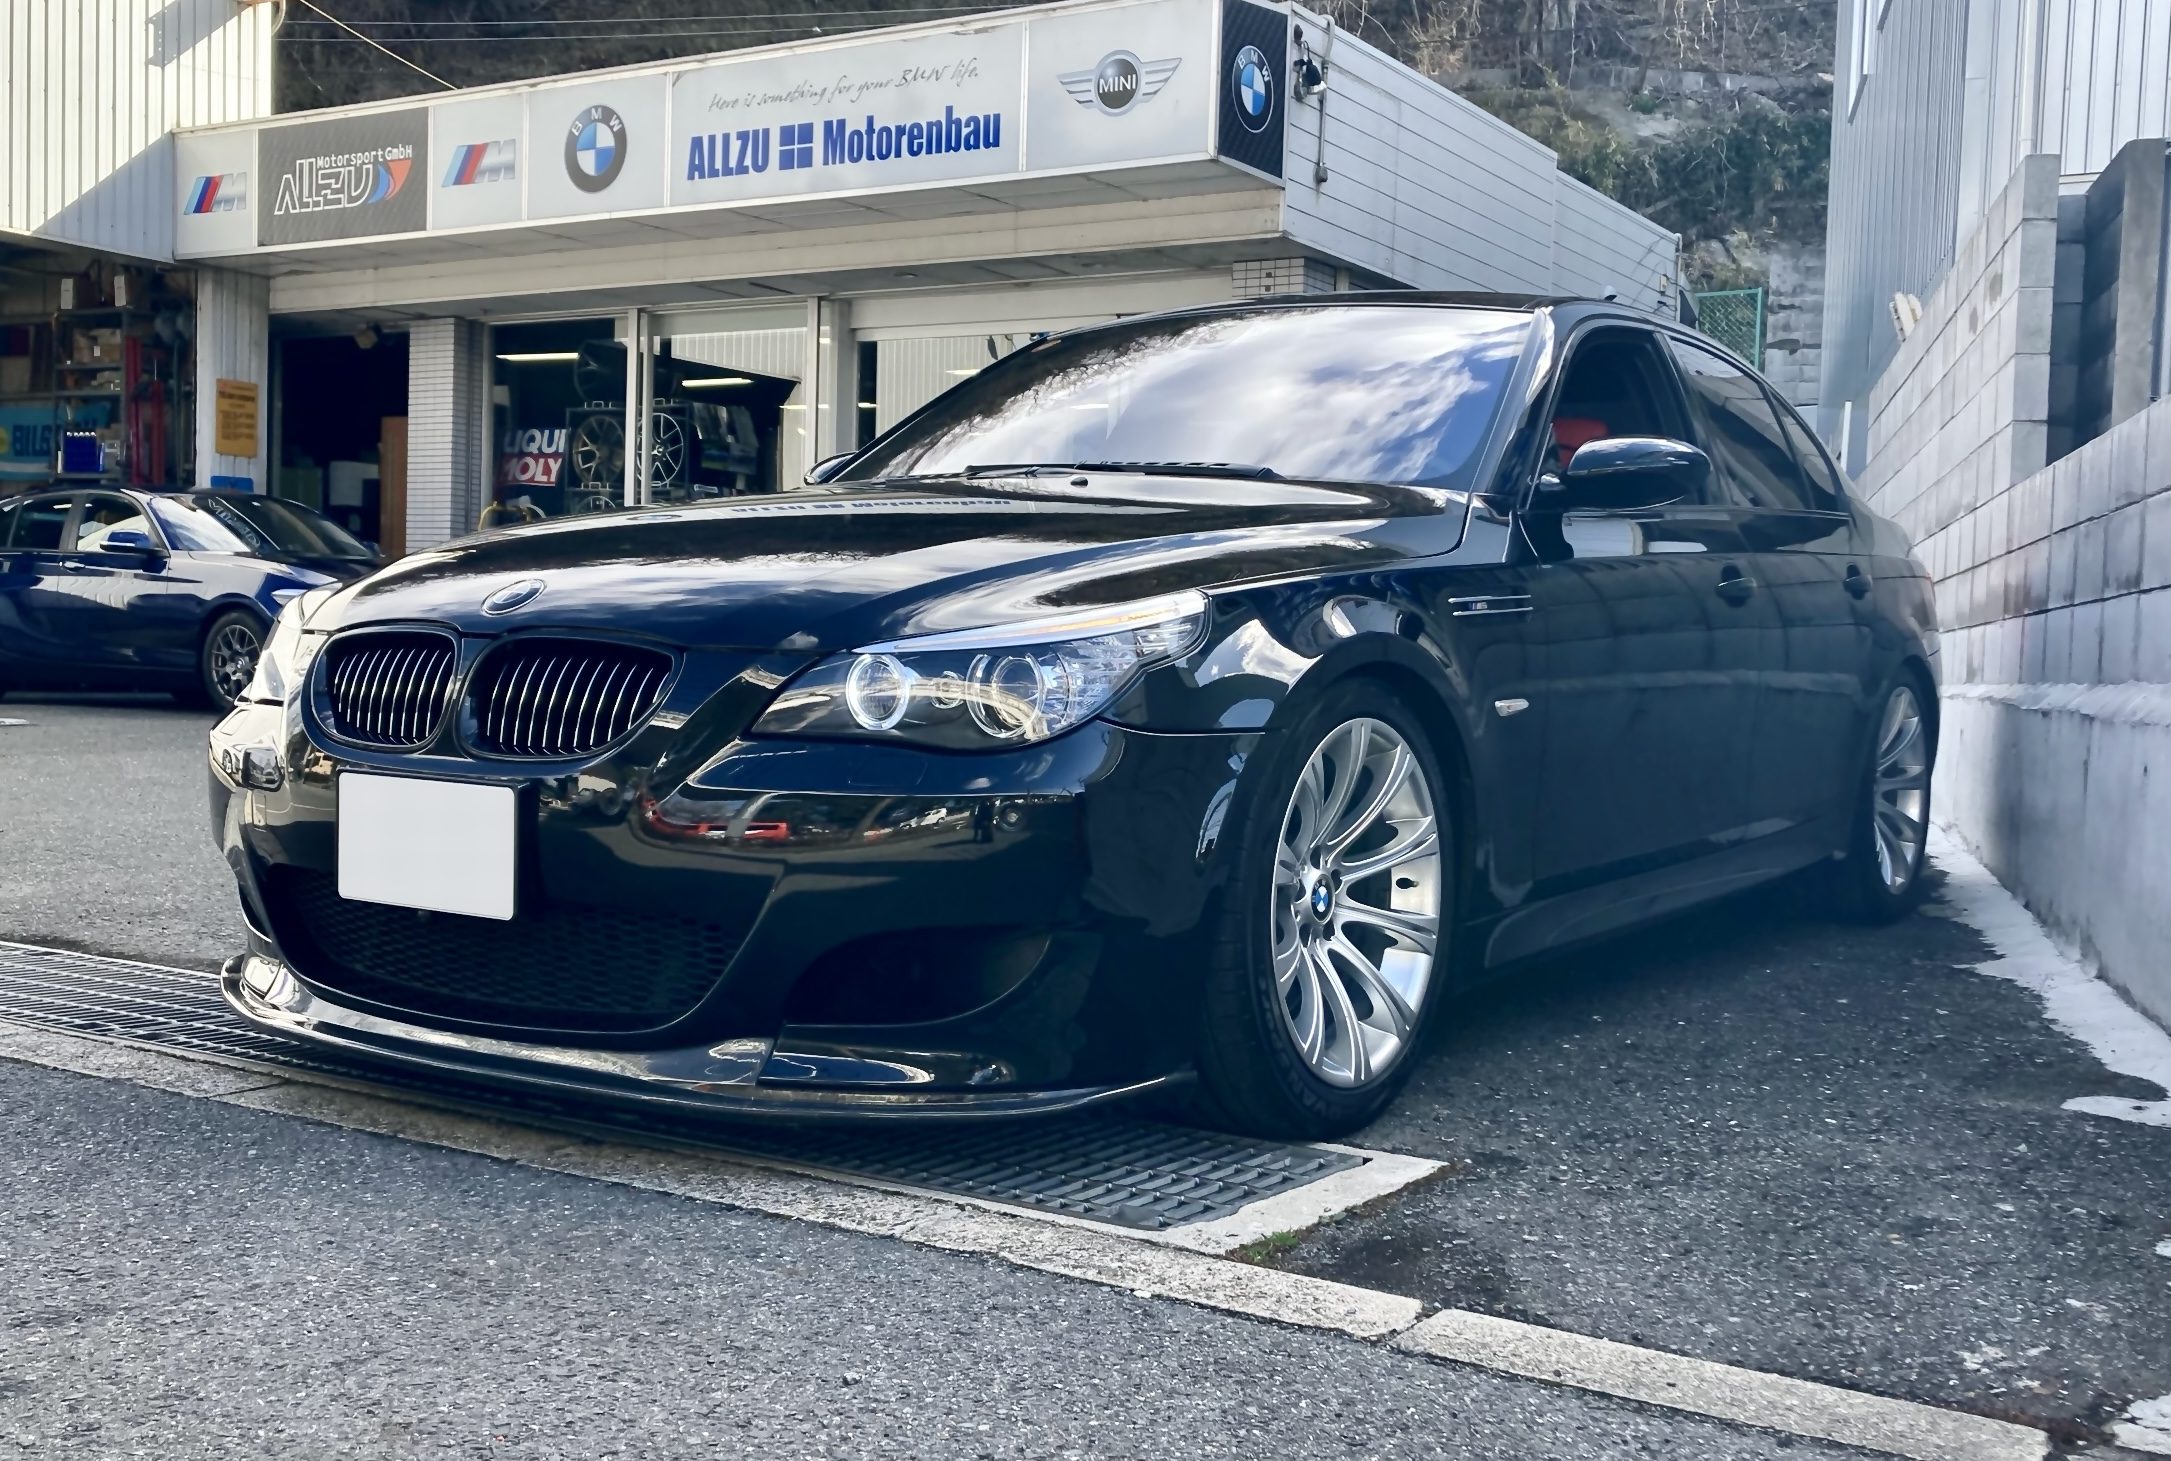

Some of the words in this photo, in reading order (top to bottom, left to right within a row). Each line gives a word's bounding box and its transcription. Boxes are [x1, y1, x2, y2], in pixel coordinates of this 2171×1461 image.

[708, 93, 739, 112] Here
[745, 92, 756, 108] is
[757, 80, 827, 106] something
[828, 74, 854, 103] for
[850, 79, 893, 103] your
[895, 65, 950, 88] BMW
[1099, 74, 1137, 94] MINI
[687, 127, 770, 180] ALLZU
[822, 105, 1000, 166] Motorenbau
[317, 148, 384, 169] Motorsport
[385, 144, 412, 160] GmbH
[503, 428, 567, 454] LIQUI
[500, 456, 562, 482] MOLY
